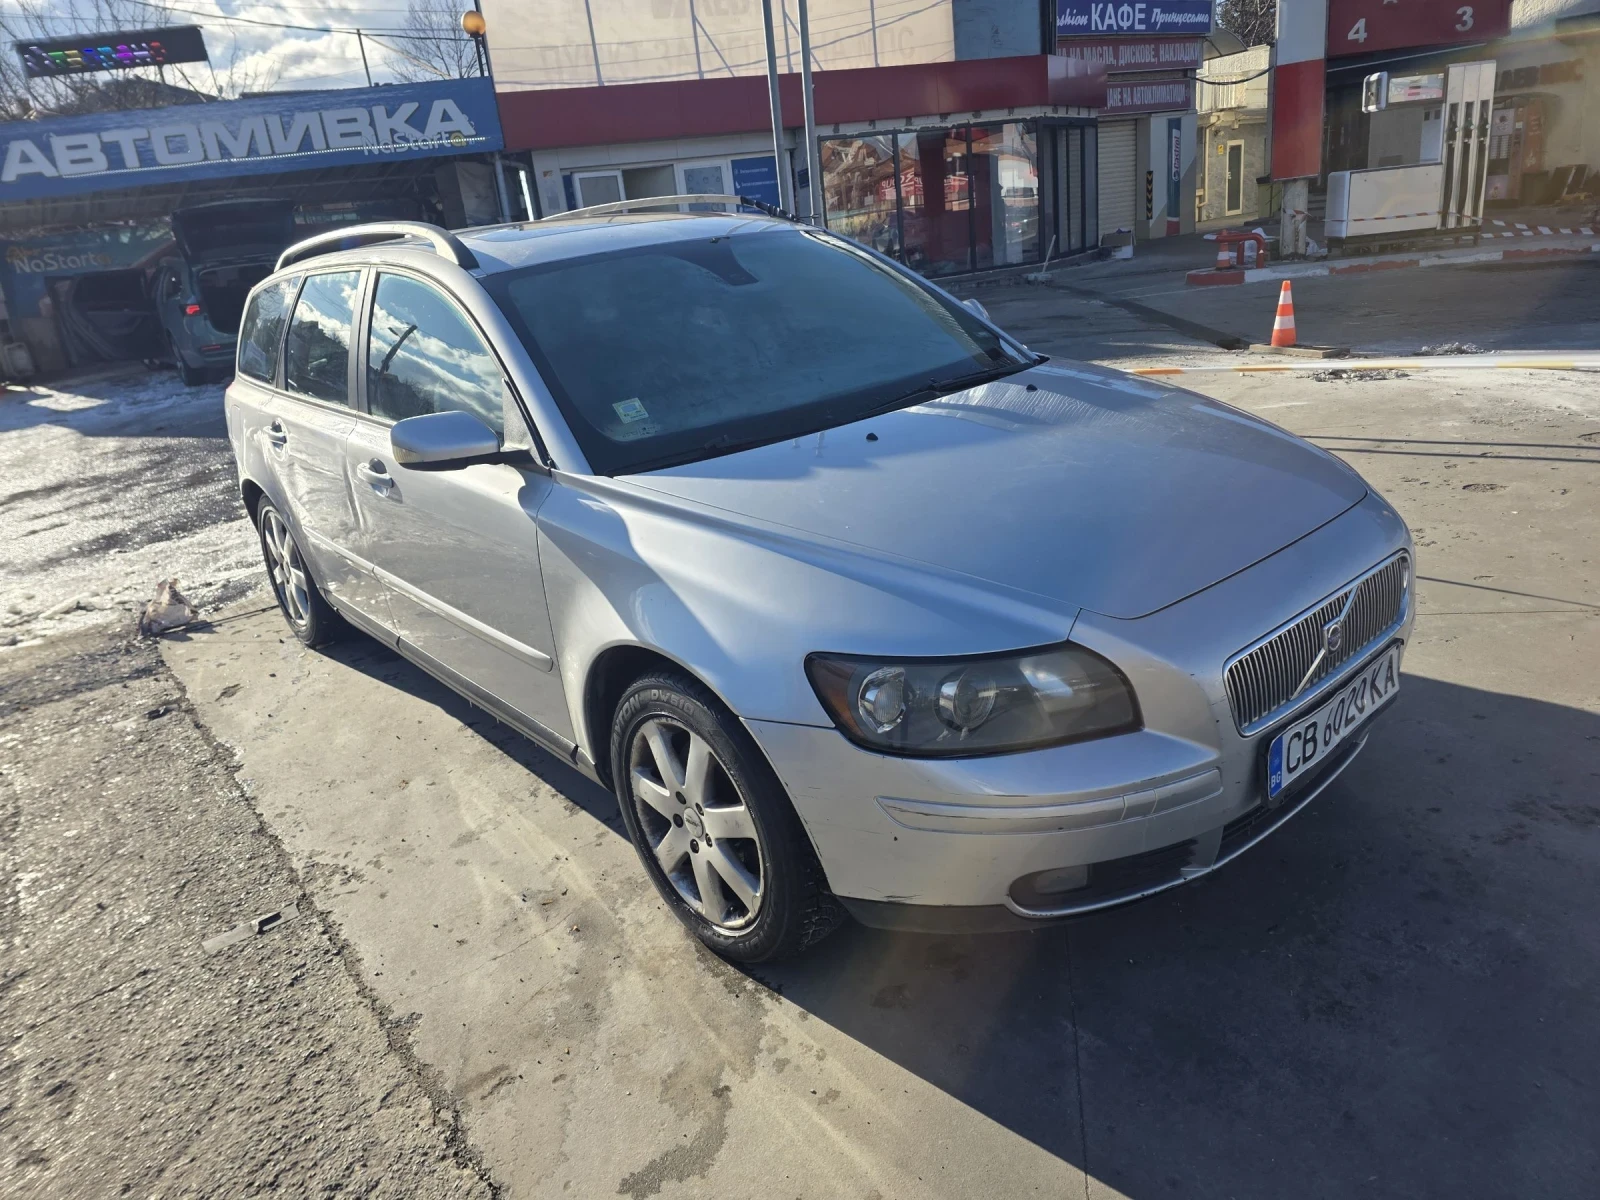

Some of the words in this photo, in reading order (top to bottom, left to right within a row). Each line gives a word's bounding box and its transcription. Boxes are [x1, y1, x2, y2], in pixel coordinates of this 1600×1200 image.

[1091, 3, 1147, 31] КАФЕ
[1347, 17, 1368, 43] 4
[1455, 6, 1474, 32] 3
[1083, 45, 1117, 67] МАСЛА,
[1119, 43, 1158, 66] ДИСКОВЕ,
[1160, 42, 1199, 63] НАКЛАДКИ
[1122, 87, 1132, 106] НА
[2, 99, 476, 182] АВТОМИВКА
[1173, 136, 1181, 169] Castrol
[1286, 721, 1318, 774] CB
[1323, 677, 1367, 748] 6020
[1370, 654, 1396, 708] KA
[1270, 771, 1282, 788] BG
